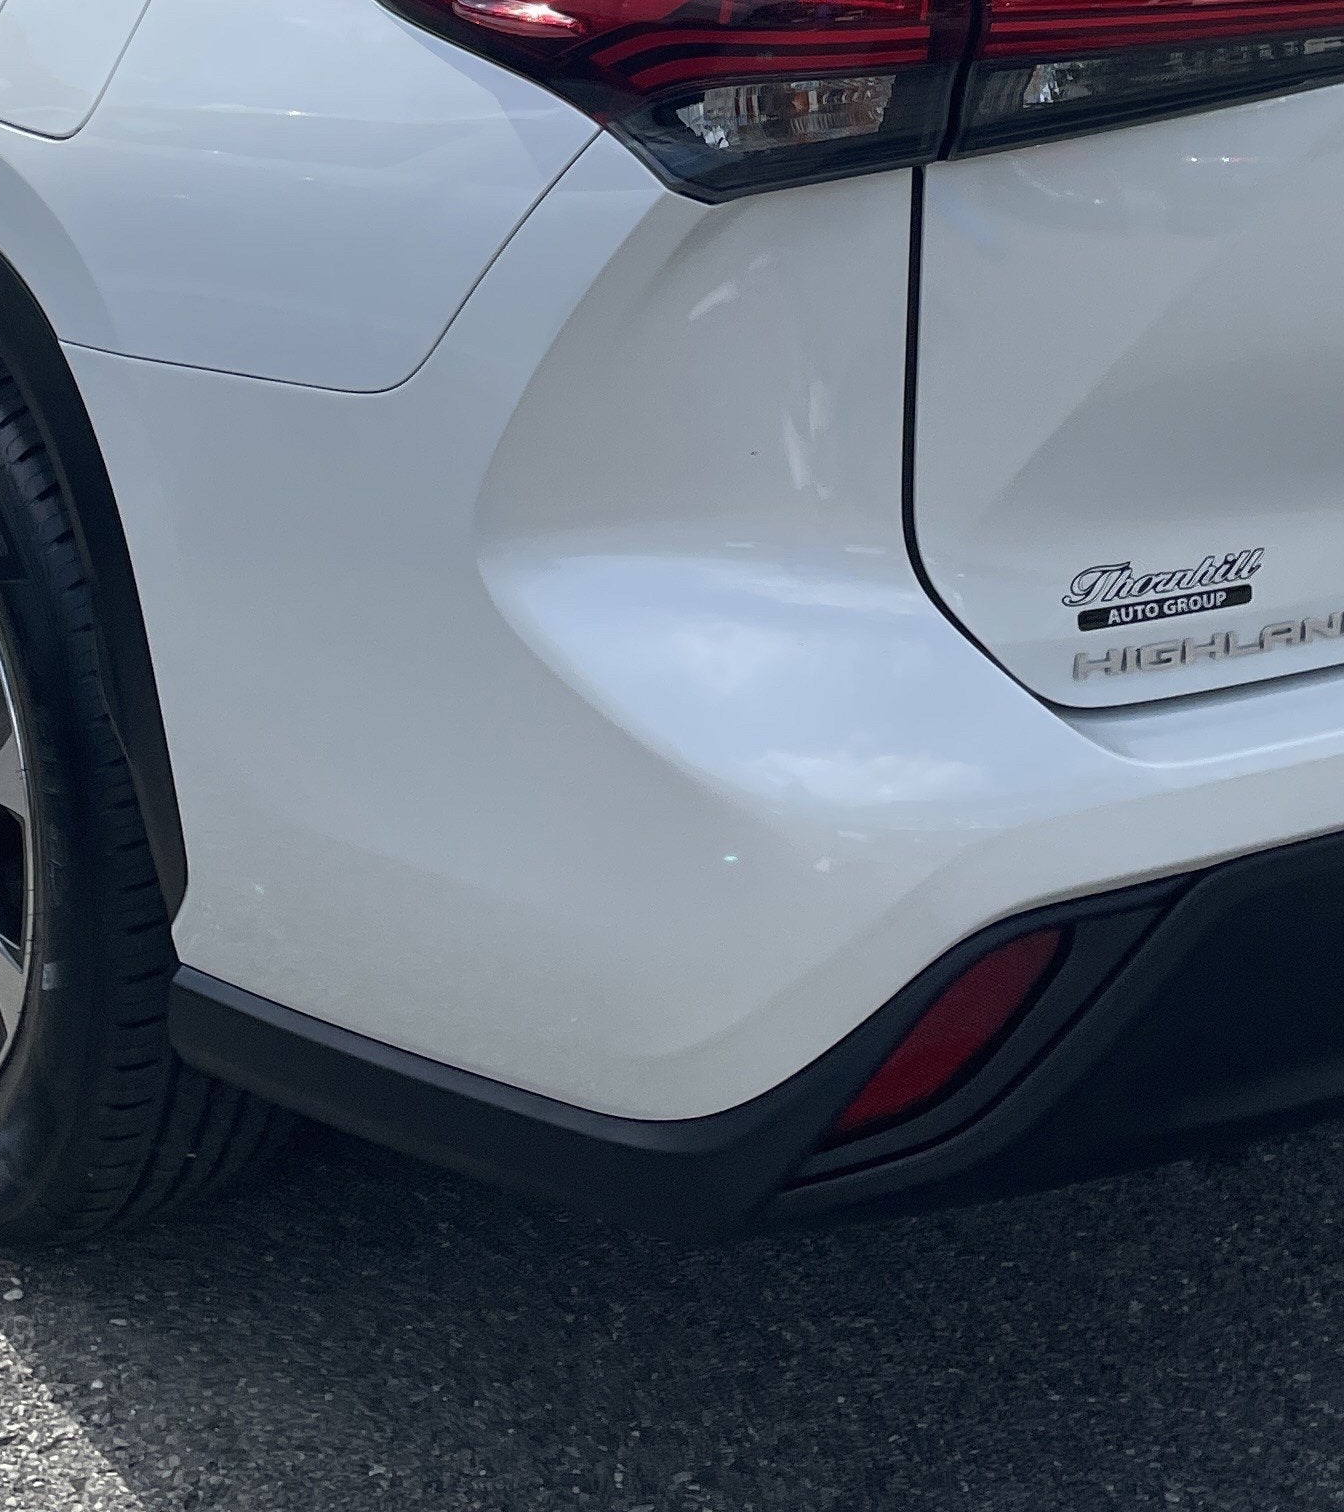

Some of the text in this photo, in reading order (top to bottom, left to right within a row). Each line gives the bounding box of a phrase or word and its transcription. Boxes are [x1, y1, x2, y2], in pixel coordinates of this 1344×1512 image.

[1060, 547, 1265, 607] Thornhill
[1107, 591, 1228, 626] AUTO GROUP
